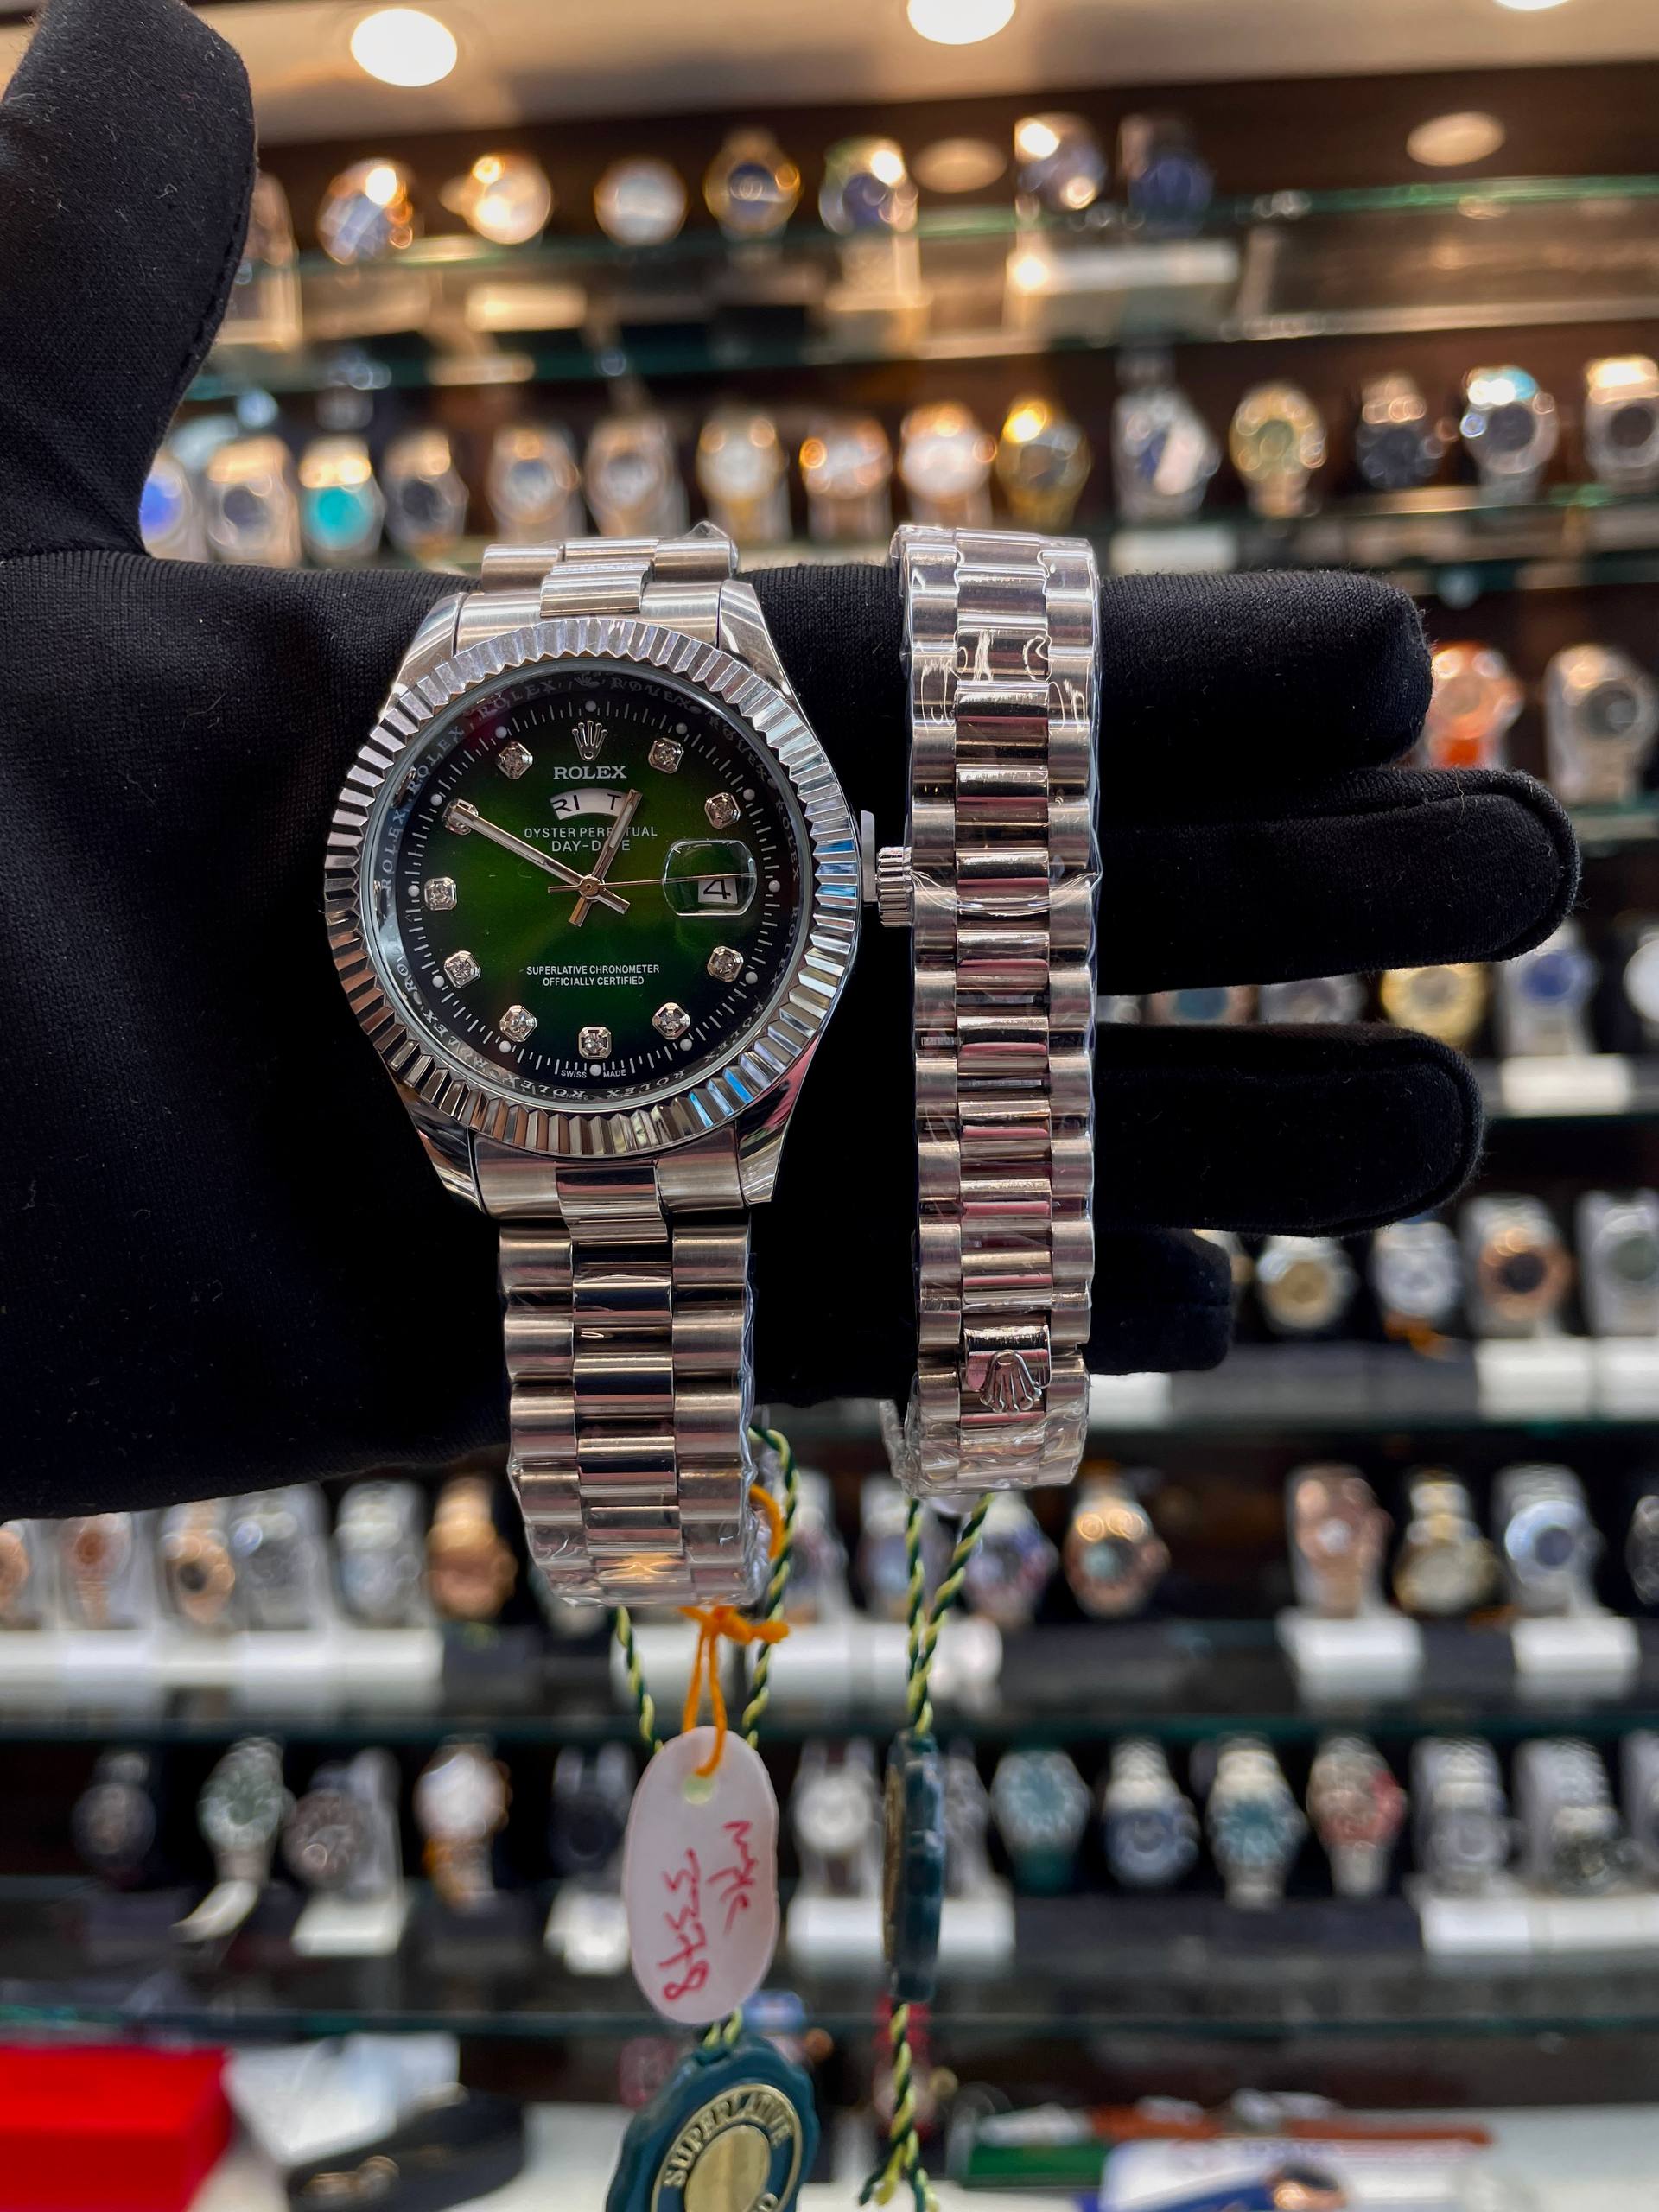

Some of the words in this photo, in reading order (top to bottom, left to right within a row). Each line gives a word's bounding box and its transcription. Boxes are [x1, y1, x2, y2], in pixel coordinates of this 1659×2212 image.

[479, 680, 556, 719] ROLEX
[407, 725, 465, 795] ROLEX
[553, 766, 627, 779] ROLEX
[524, 828, 576, 838] OYSTER
[580, 826, 658, 837] PERPTUAL
[551, 840, 631, 852] DAY-DE
[776, 800, 799, 882] ROLEX
[381, 808, 406, 891] ROLEX
[526, 965, 588, 976] SUPERLATIVE
[589, 964, 659, 975] CHRONOMETER
[543, 977, 596, 987] OFFICIALLY
[597, 976, 645, 986] CERTIFIED
[561, 1070, 588, 1078] SWISS
[603, 1069, 627, 1078] MADE
[607, 1069, 686, 1098] ROLEX
